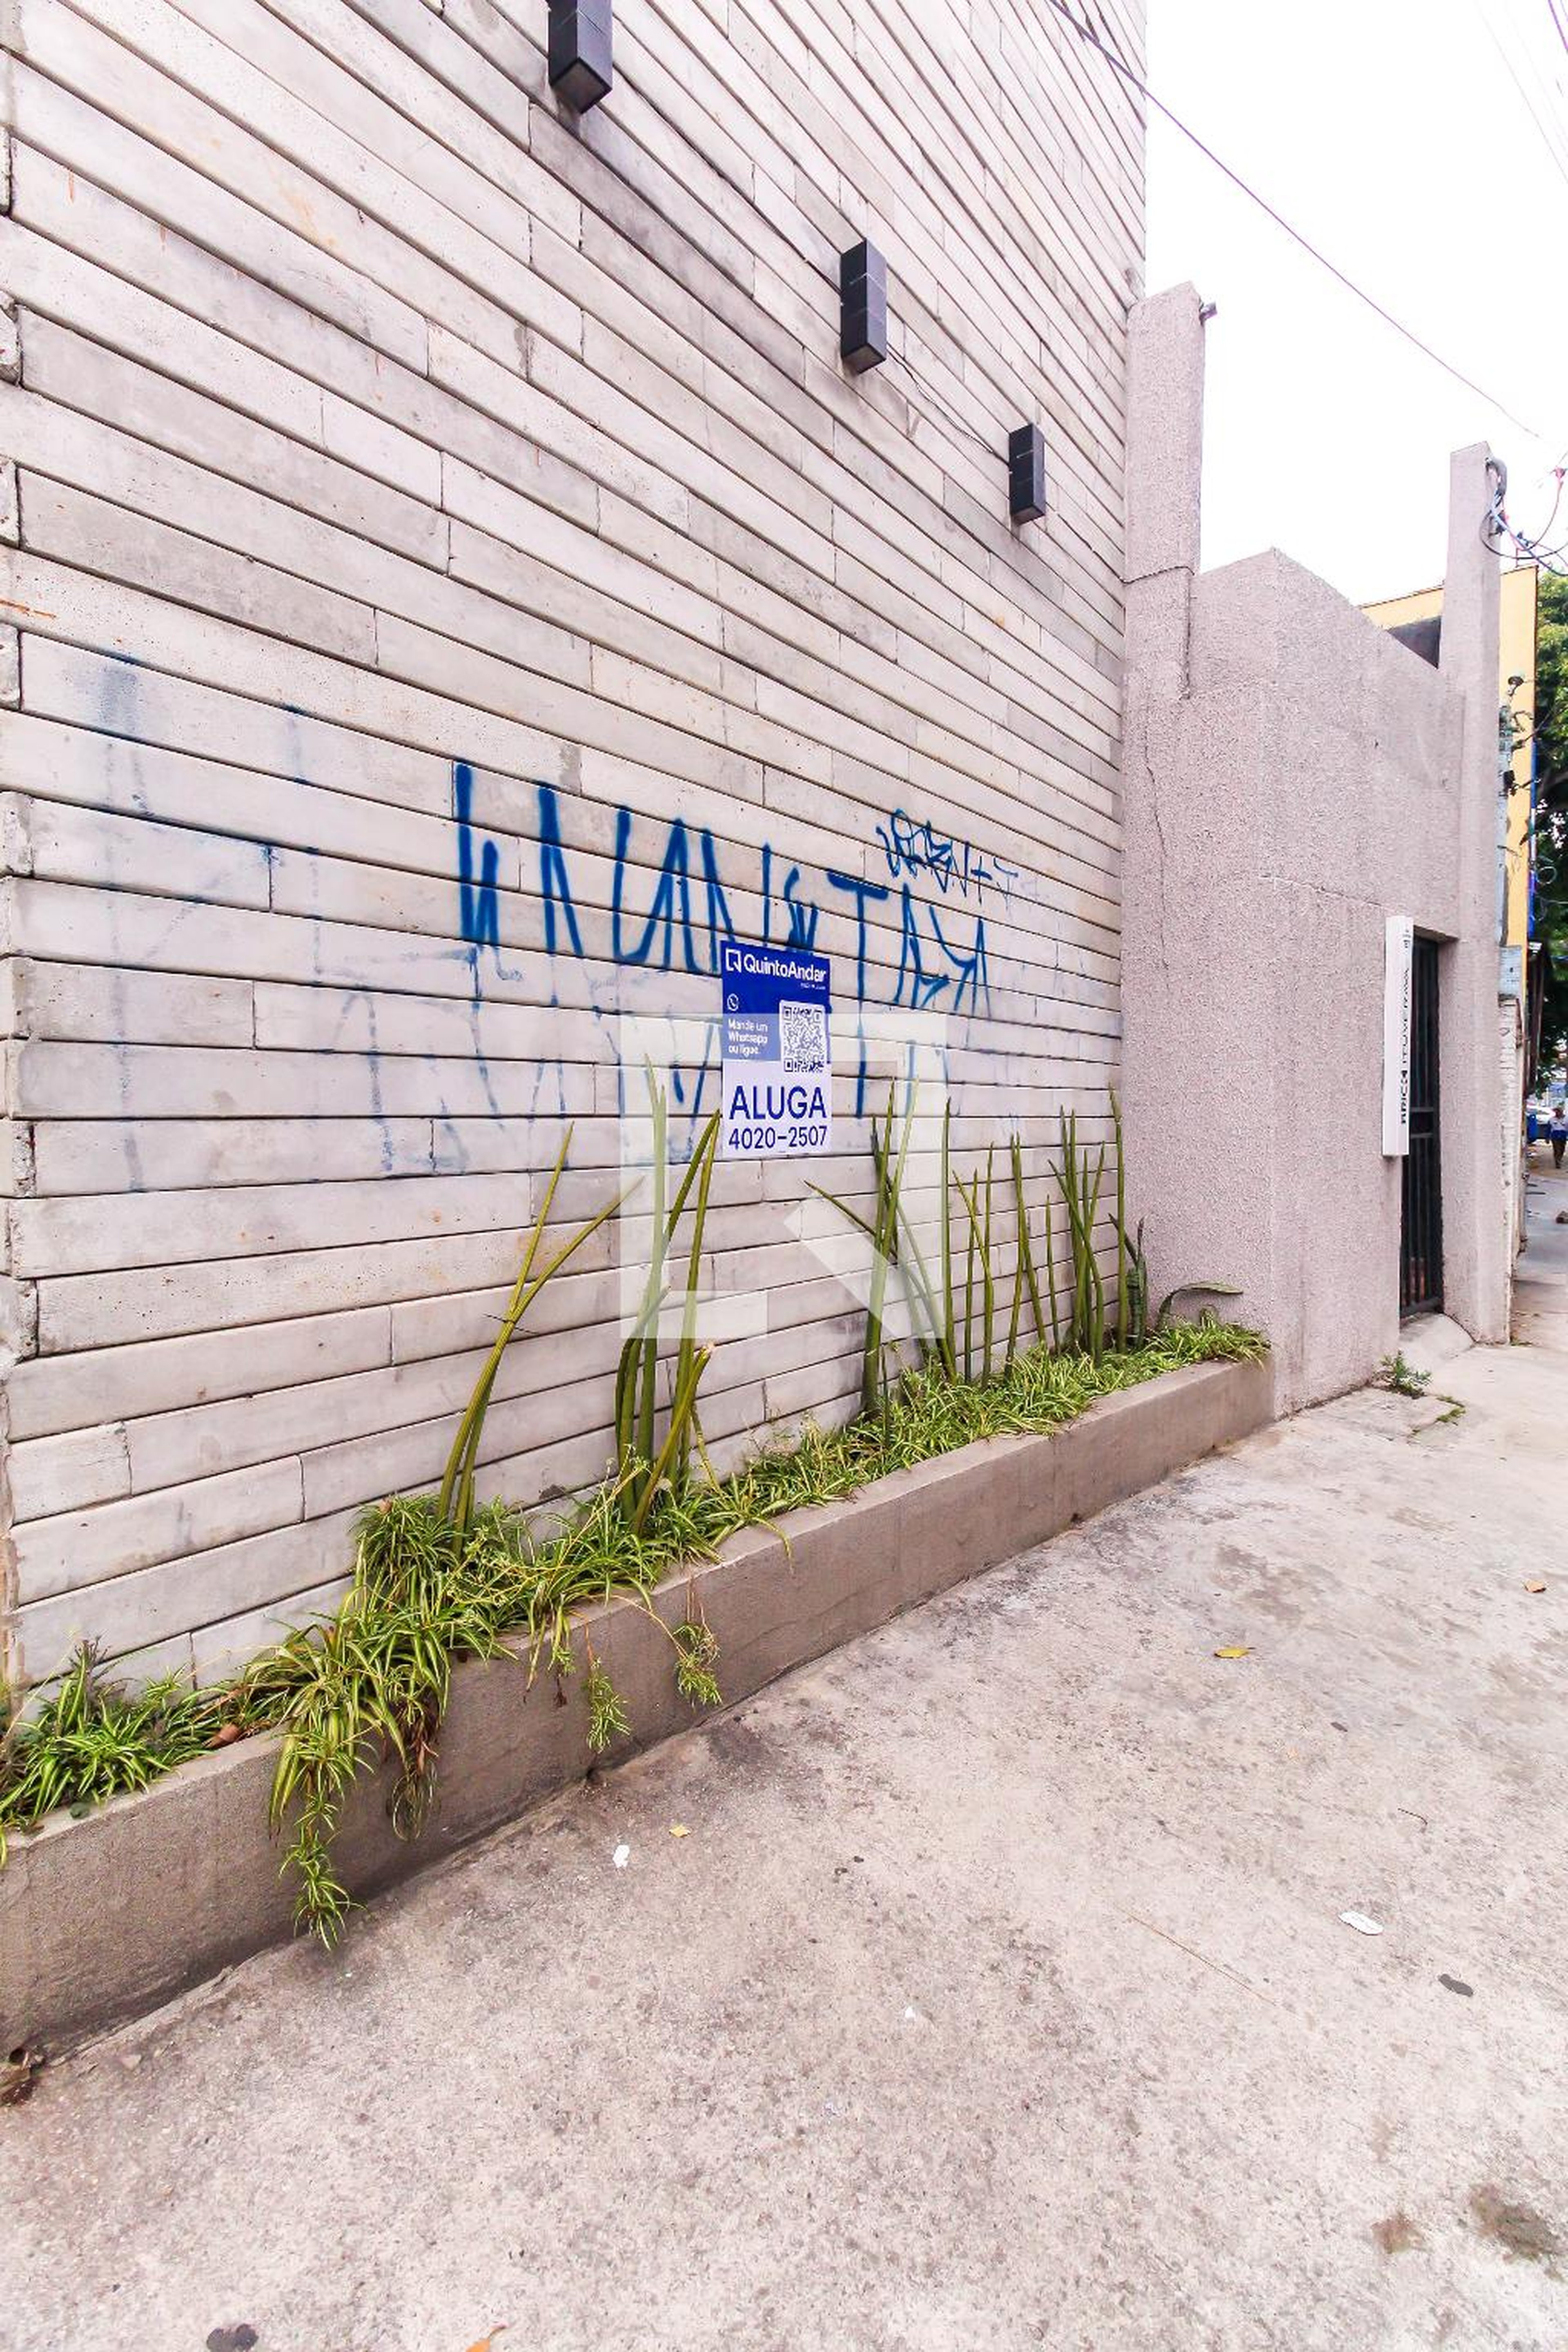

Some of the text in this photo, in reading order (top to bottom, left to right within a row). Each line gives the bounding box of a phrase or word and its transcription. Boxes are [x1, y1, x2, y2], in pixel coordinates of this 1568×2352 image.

[744, 953, 826, 982] QuintoAndar
[728, 1018, 768, 1033] Mande um
[728, 1031, 768, 1047] Whatsapp
[728, 1045, 739, 1054] ou
[728, 1085, 827, 1120] ALUGA
[728, 1125, 827, 1150] 4020-2507
